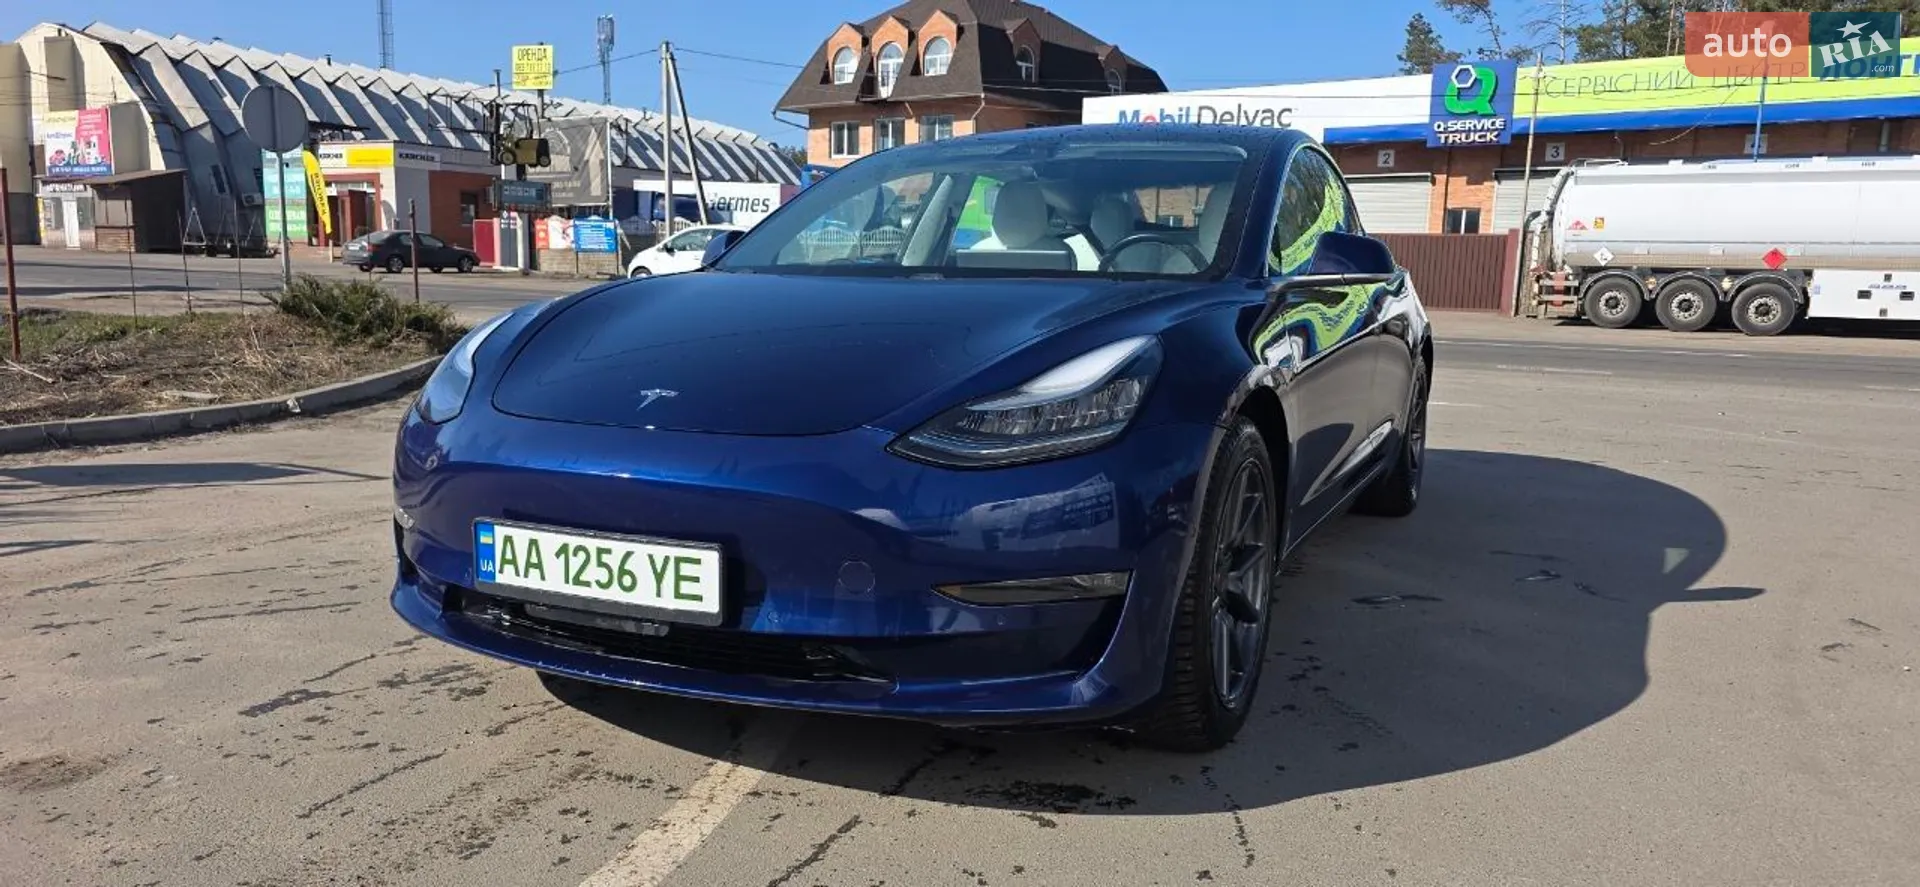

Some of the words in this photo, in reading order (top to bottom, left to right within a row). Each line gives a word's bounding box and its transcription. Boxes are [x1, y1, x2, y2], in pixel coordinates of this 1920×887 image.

[517, 48, 548, 61] ОРЕНДА
[1544, 68, 1695, 98] СЕРВІСНИЙ
[1118, 106, 1191, 125] Mobil
[1197, 104, 1293, 128] Delvac
[1437, 131, 1499, 144] TRUCK
[1382, 152, 1391, 164] 2
[1551, 145, 1560, 158] 3
[480, 559, 495, 573] UA
[498, 535, 546, 581] AA
[554, 543, 638, 593] 1256
[648, 553, 704, 602] YE
